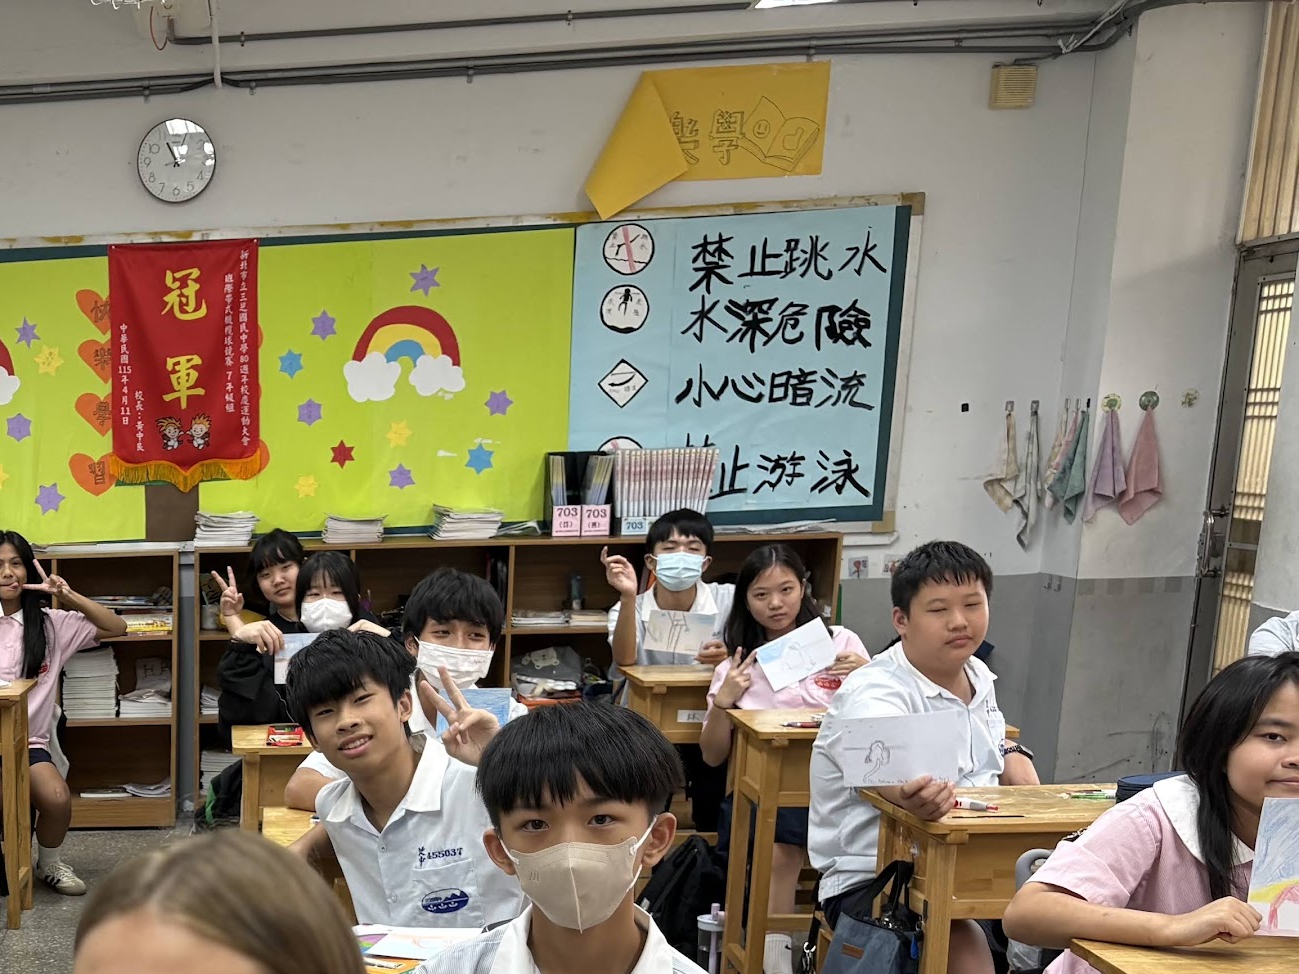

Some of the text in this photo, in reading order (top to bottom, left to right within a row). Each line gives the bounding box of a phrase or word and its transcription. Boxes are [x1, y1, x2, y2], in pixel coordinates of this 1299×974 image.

[149, 143, 160, 154] 10
[144, 157, 151, 167] 9
[149, 172, 156, 183] 8
[196, 170, 203, 180] 4
[159, 182, 165, 194] 7
[173, 185, 180, 196] 6
[187, 181, 194, 192] 5
[688, 227, 888, 294] 禁止跳水
[679, 295, 874, 354] 水深危險
[161, 267, 207, 409] 冠軍
[118, 323, 132, 425] 中華民國115年4月11日
[675, 364, 874, 412] 小心暗流
[684, 433, 870, 498] 止游泳
[557, 507, 578, 517] 703
[586, 509, 607, 519] 703
[626, 522, 643, 530] 703
[427, 847, 463, 860] 455037
